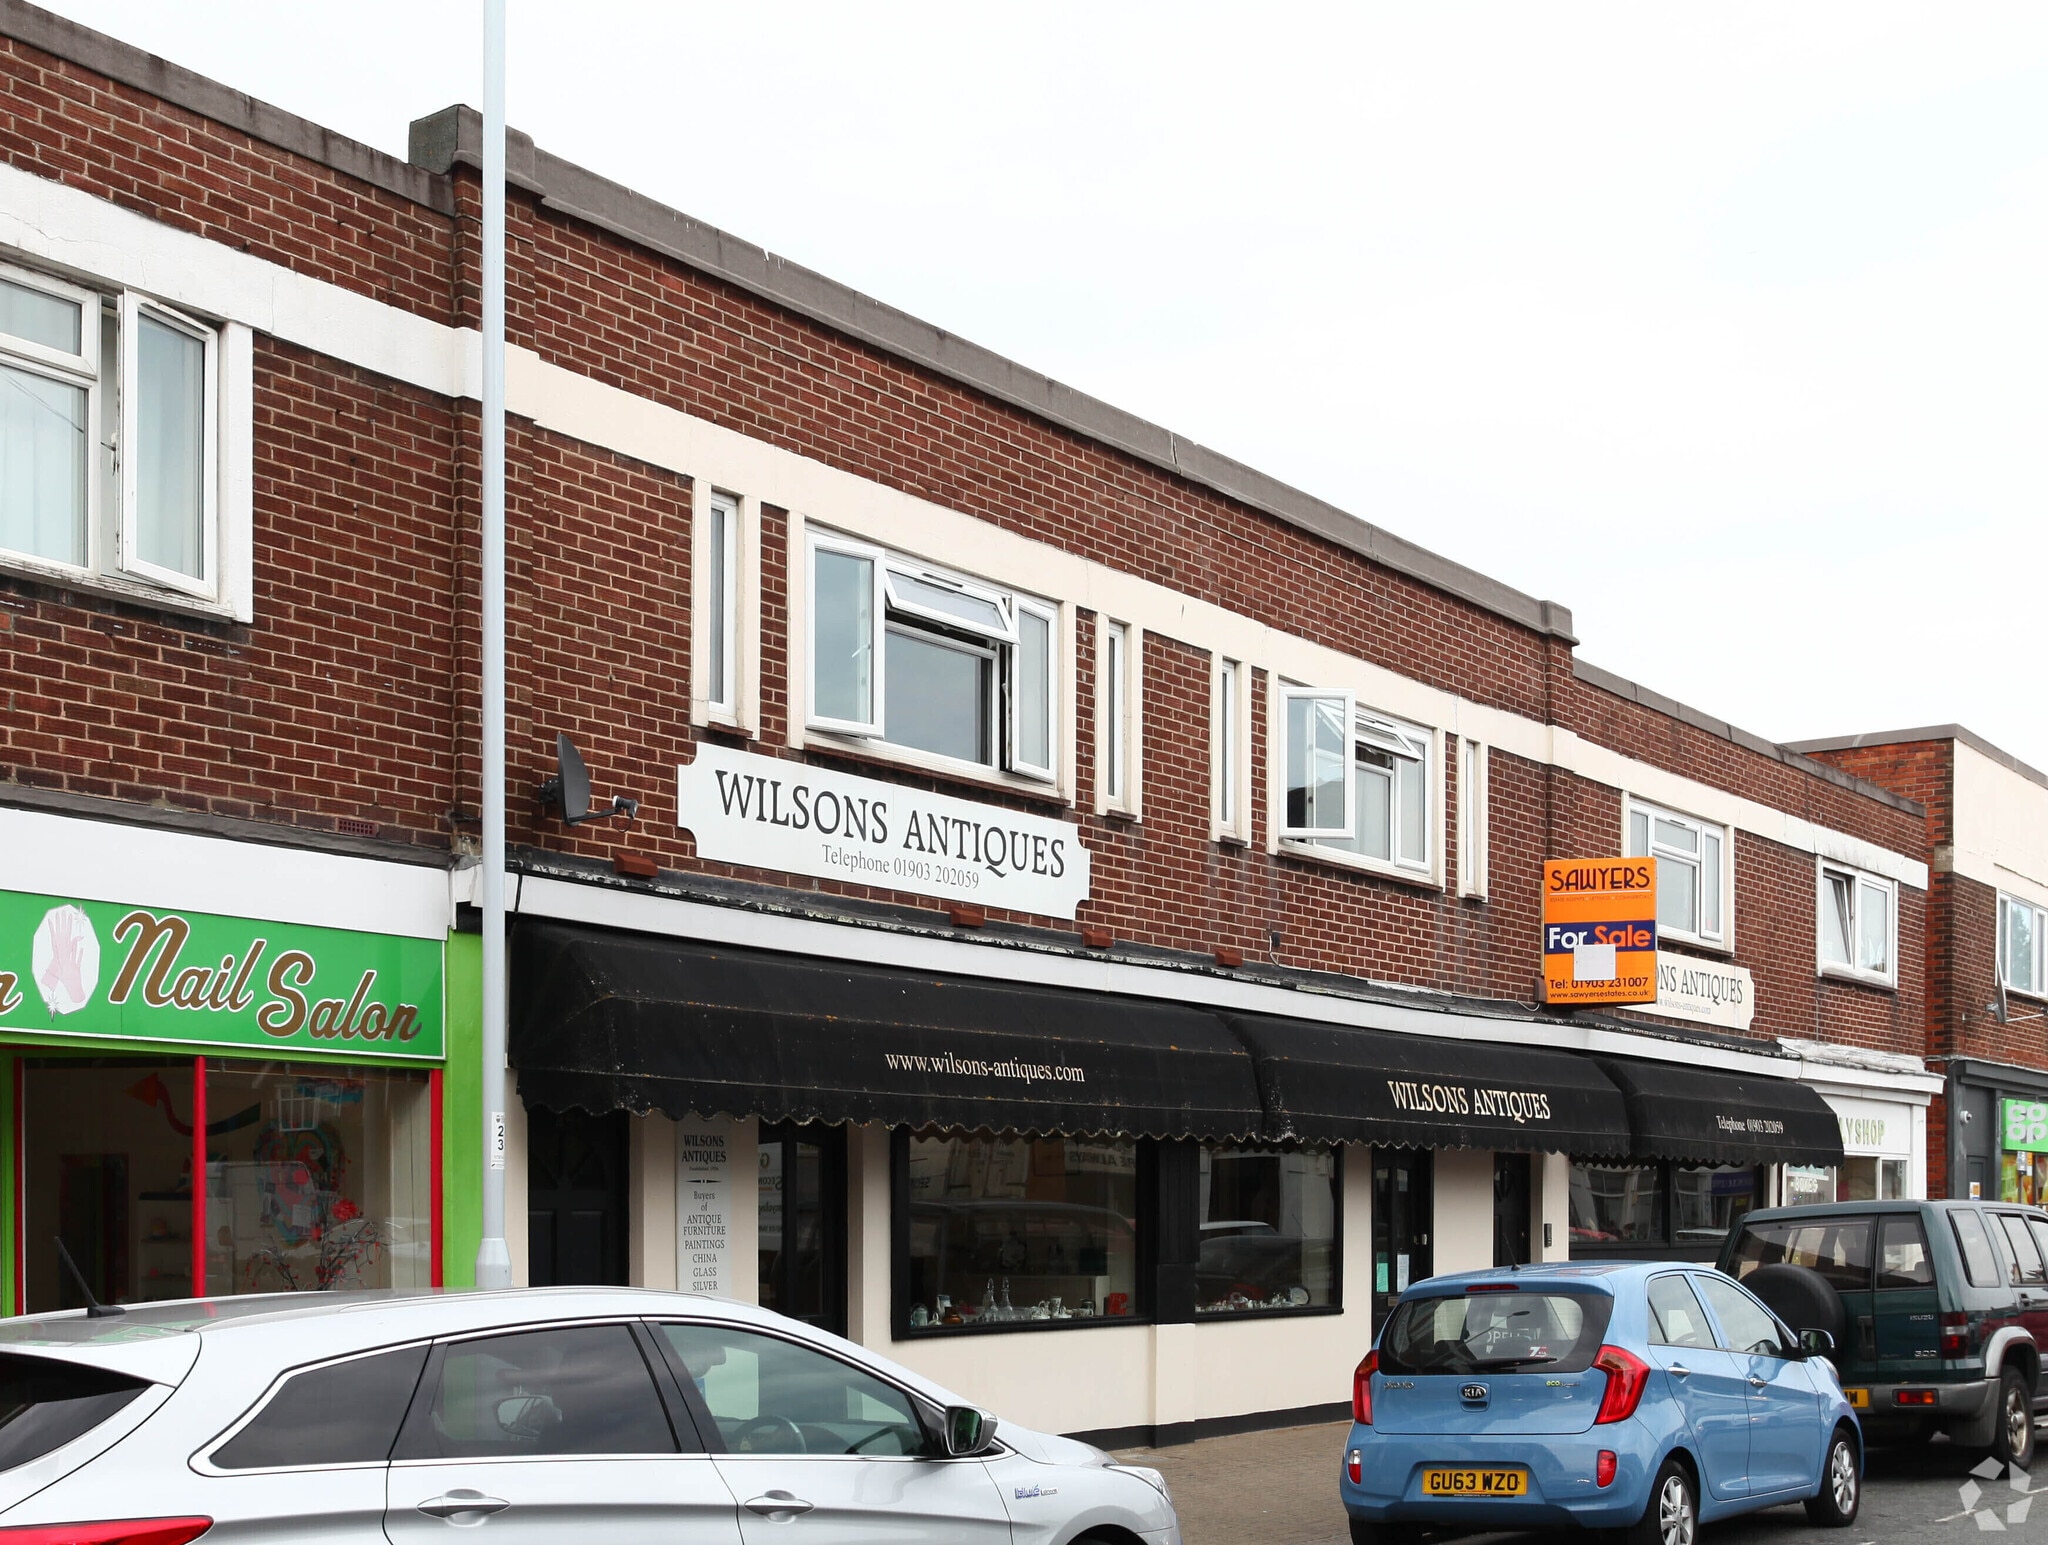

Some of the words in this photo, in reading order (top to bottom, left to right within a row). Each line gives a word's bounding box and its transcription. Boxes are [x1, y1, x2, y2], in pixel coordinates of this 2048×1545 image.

[714, 769, 889, 844] WILSONS
[902, 809, 1066, 879] ANTIQUES
[821, 844, 890, 875] Telephone
[893, 860, 931, 881] 01903
[934, 864, 980, 890] 202059
[1550, 866, 1651, 891] SAWYERS
[1548, 926, 1588, 950] For
[1594, 924, 1652, 948] Sale
[108, 909, 254, 1012] Nail
[257, 949, 423, 1042] Salon
[1549, 979, 1568, 990] Tel:
[1608, 976, 1649, 988] 231007
[1680, 968, 1743, 1006] ANTIQUES
[1549, 990, 1649, 999] www.sawyersestates.co.uk
[885, 1051, 1086, 1085] www.wilsons-antiques.com
[1387, 1080, 1470, 1115] WILSONS
[1474, 1088, 1551, 1124] ANTIQUES
[1715, 1115, 1746, 1134] Telephone
[683, 1134, 725, 1148] WILSONS
[681, 1150, 727, 1165] ANTIQUES
[693, 1190, 716, 1202] Buyers
[700, 1202, 708, 1212] of
[686, 1214, 722, 1226] ANTIQUE
[683, 1225, 726, 1236] FURNITURE
[684, 1239, 725, 1250] PAINTINGS
[692, 1253, 718, 1264] CHINA
[692, 1266, 717, 1277] GLASS
[692, 1280, 719, 1291] SILVER
[1463, 1388, 1484, 1398] KIA
[1430, 1472, 1477, 1491] GU63
[1481, 1472, 1519, 1491] WZO
